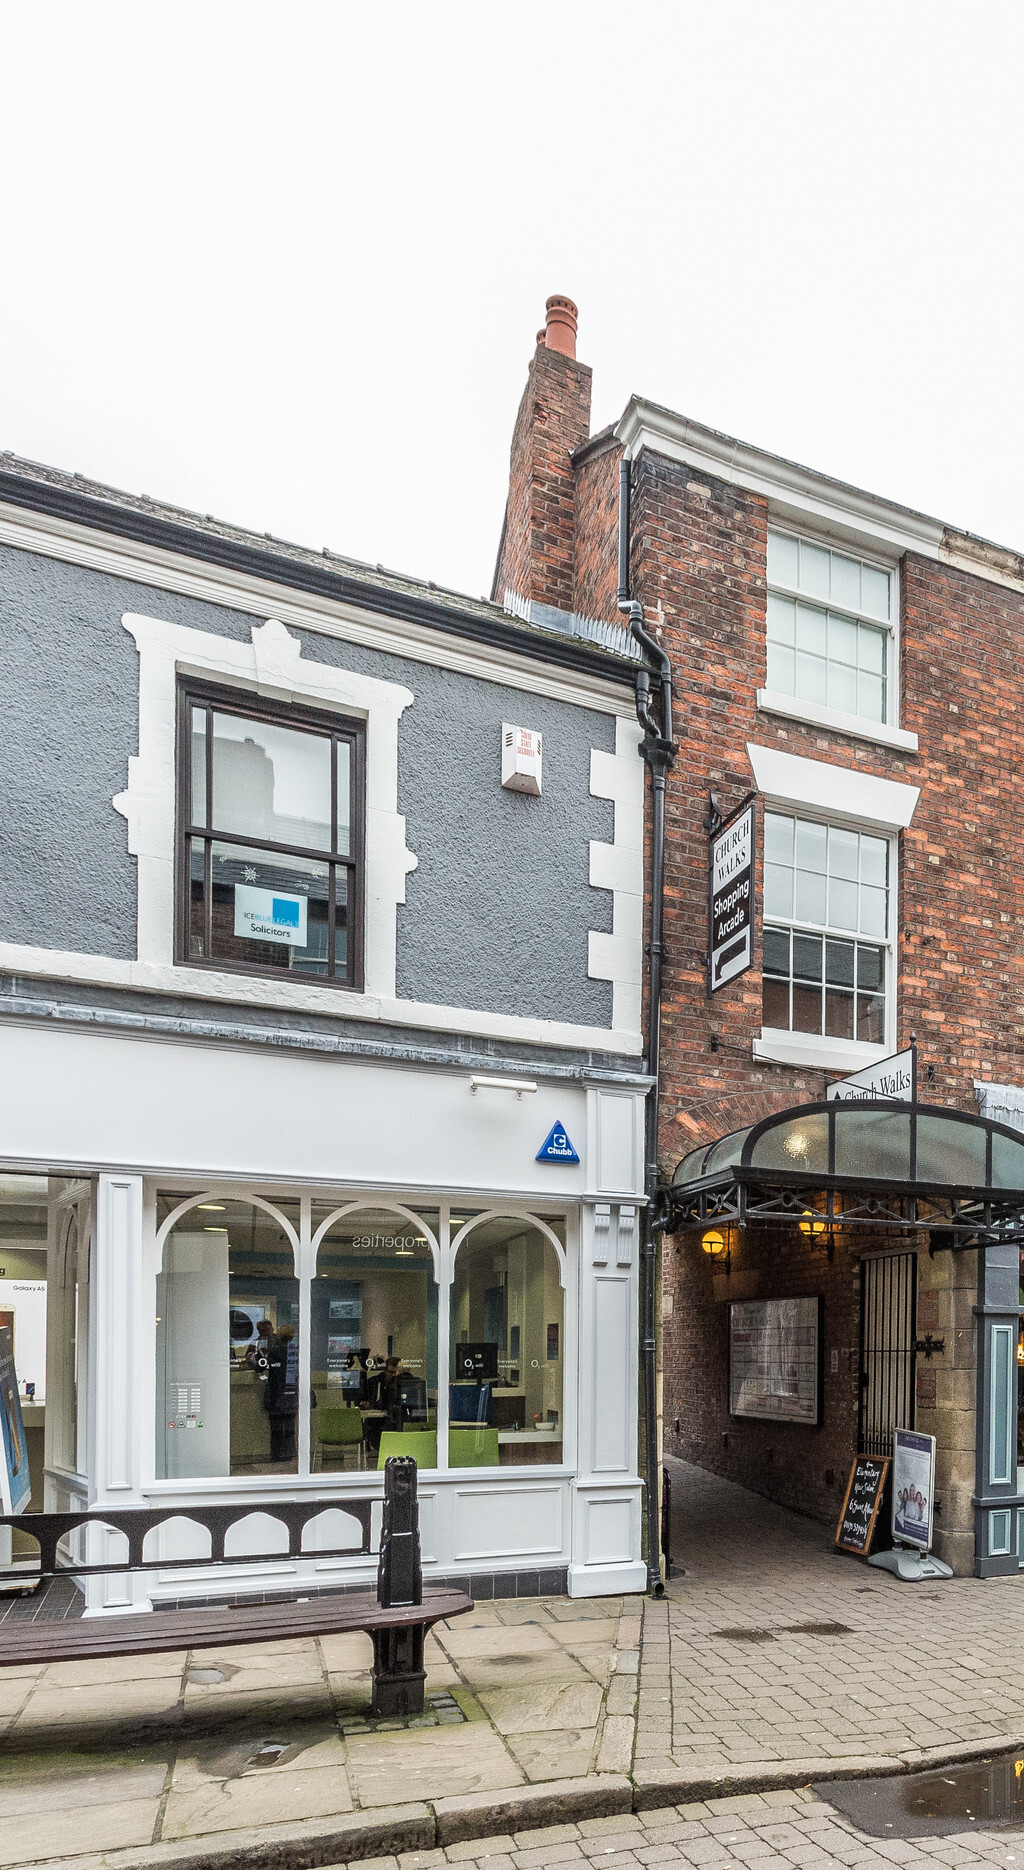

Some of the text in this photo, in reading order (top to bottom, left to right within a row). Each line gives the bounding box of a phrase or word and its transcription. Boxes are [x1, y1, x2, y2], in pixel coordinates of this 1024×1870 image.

[715, 819, 750, 863] CHURCH
[718, 846, 746, 882] WALKS
[714, 881, 750, 918] Shopping
[250, 922, 292, 938] Solicitors
[717, 907, 745, 940] Arcade
[879, 1070, 911, 1096] Walks
[547, 1147, 573, 1156] Chubb
